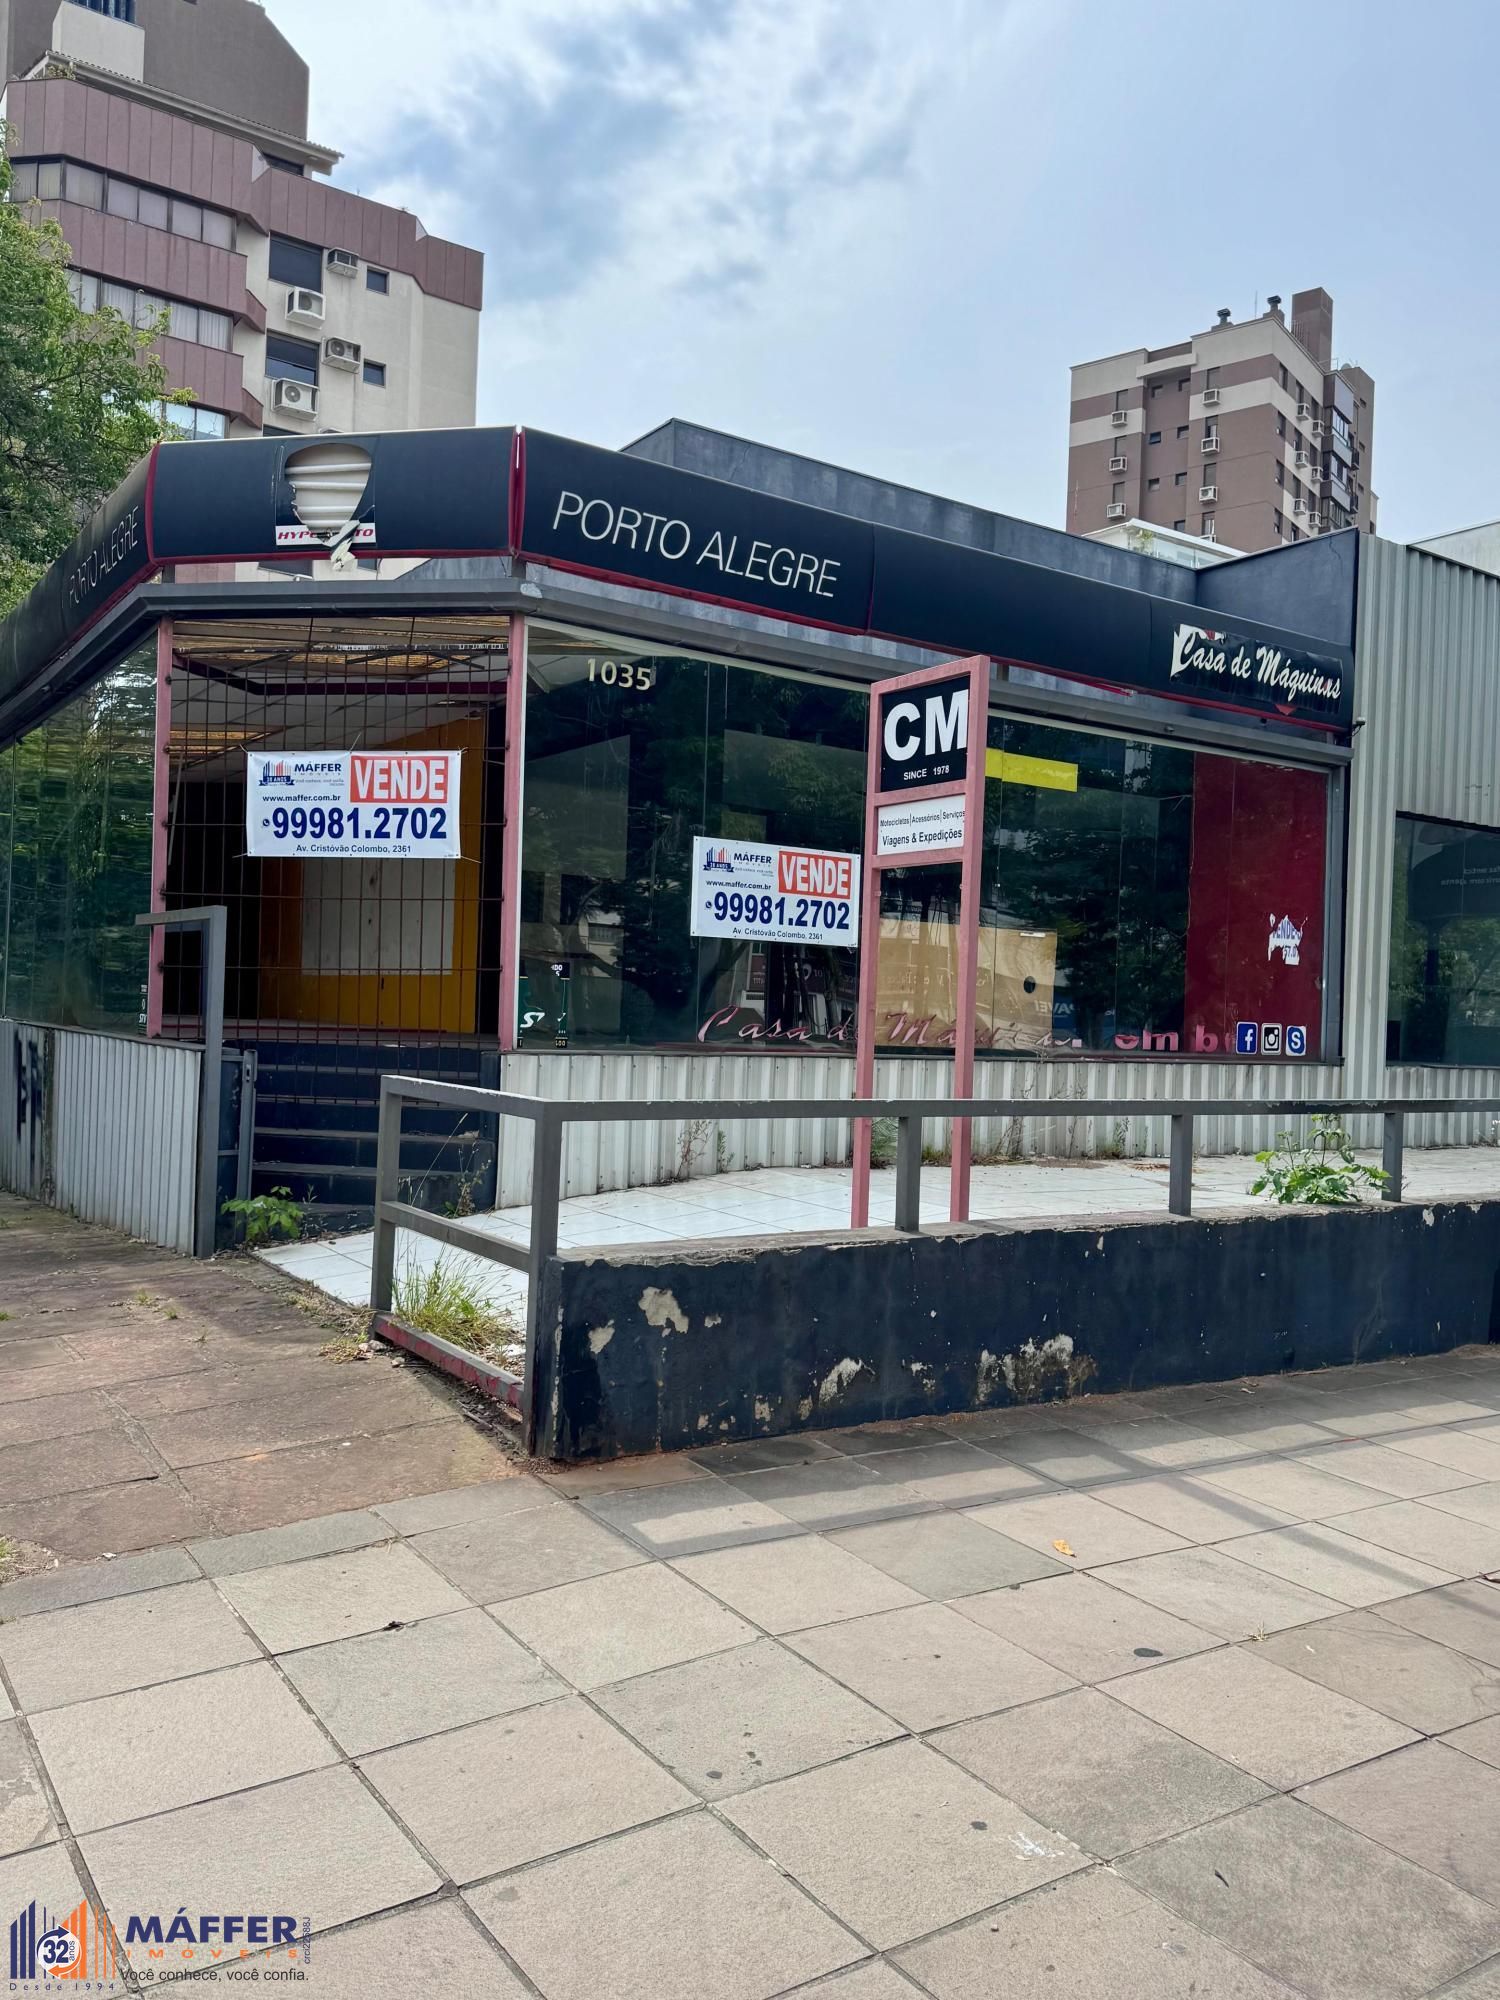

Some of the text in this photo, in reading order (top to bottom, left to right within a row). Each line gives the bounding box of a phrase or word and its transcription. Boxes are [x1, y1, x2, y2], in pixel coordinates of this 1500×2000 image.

[100, 505, 138, 581] ALEGRE
[552, 490, 841, 598] PORTO ALEGRE
[1179, 629, 1227, 674] Casa
[1230, 646, 1251, 679] de
[586, 657, 652, 691] 1035
[884, 689, 969, 761] CM
[294, 761, 342, 772] MÁFFER
[354, 759, 446, 800] VENDE
[903, 764, 950, 780] SINCE 1978
[262, 794, 341, 802] www.maffer.com.br
[272, 806, 447, 840] 99981.2702
[911, 813, 940, 823] Acessórios
[296, 844, 308, 853] Av.
[310, 844, 350, 853] Cristóvão
[351, 845, 391, 854] Colombo,
[882, 829, 962, 847] Viagens & Expedições
[733, 851, 772, 864] MÁFFER
[705, 879, 772, 891] www.maffer.com.br
[781, 854, 849, 896] VENDE
[714, 891, 850, 930] 99981.2702
[744, 928, 776, 937] Cristóvão
